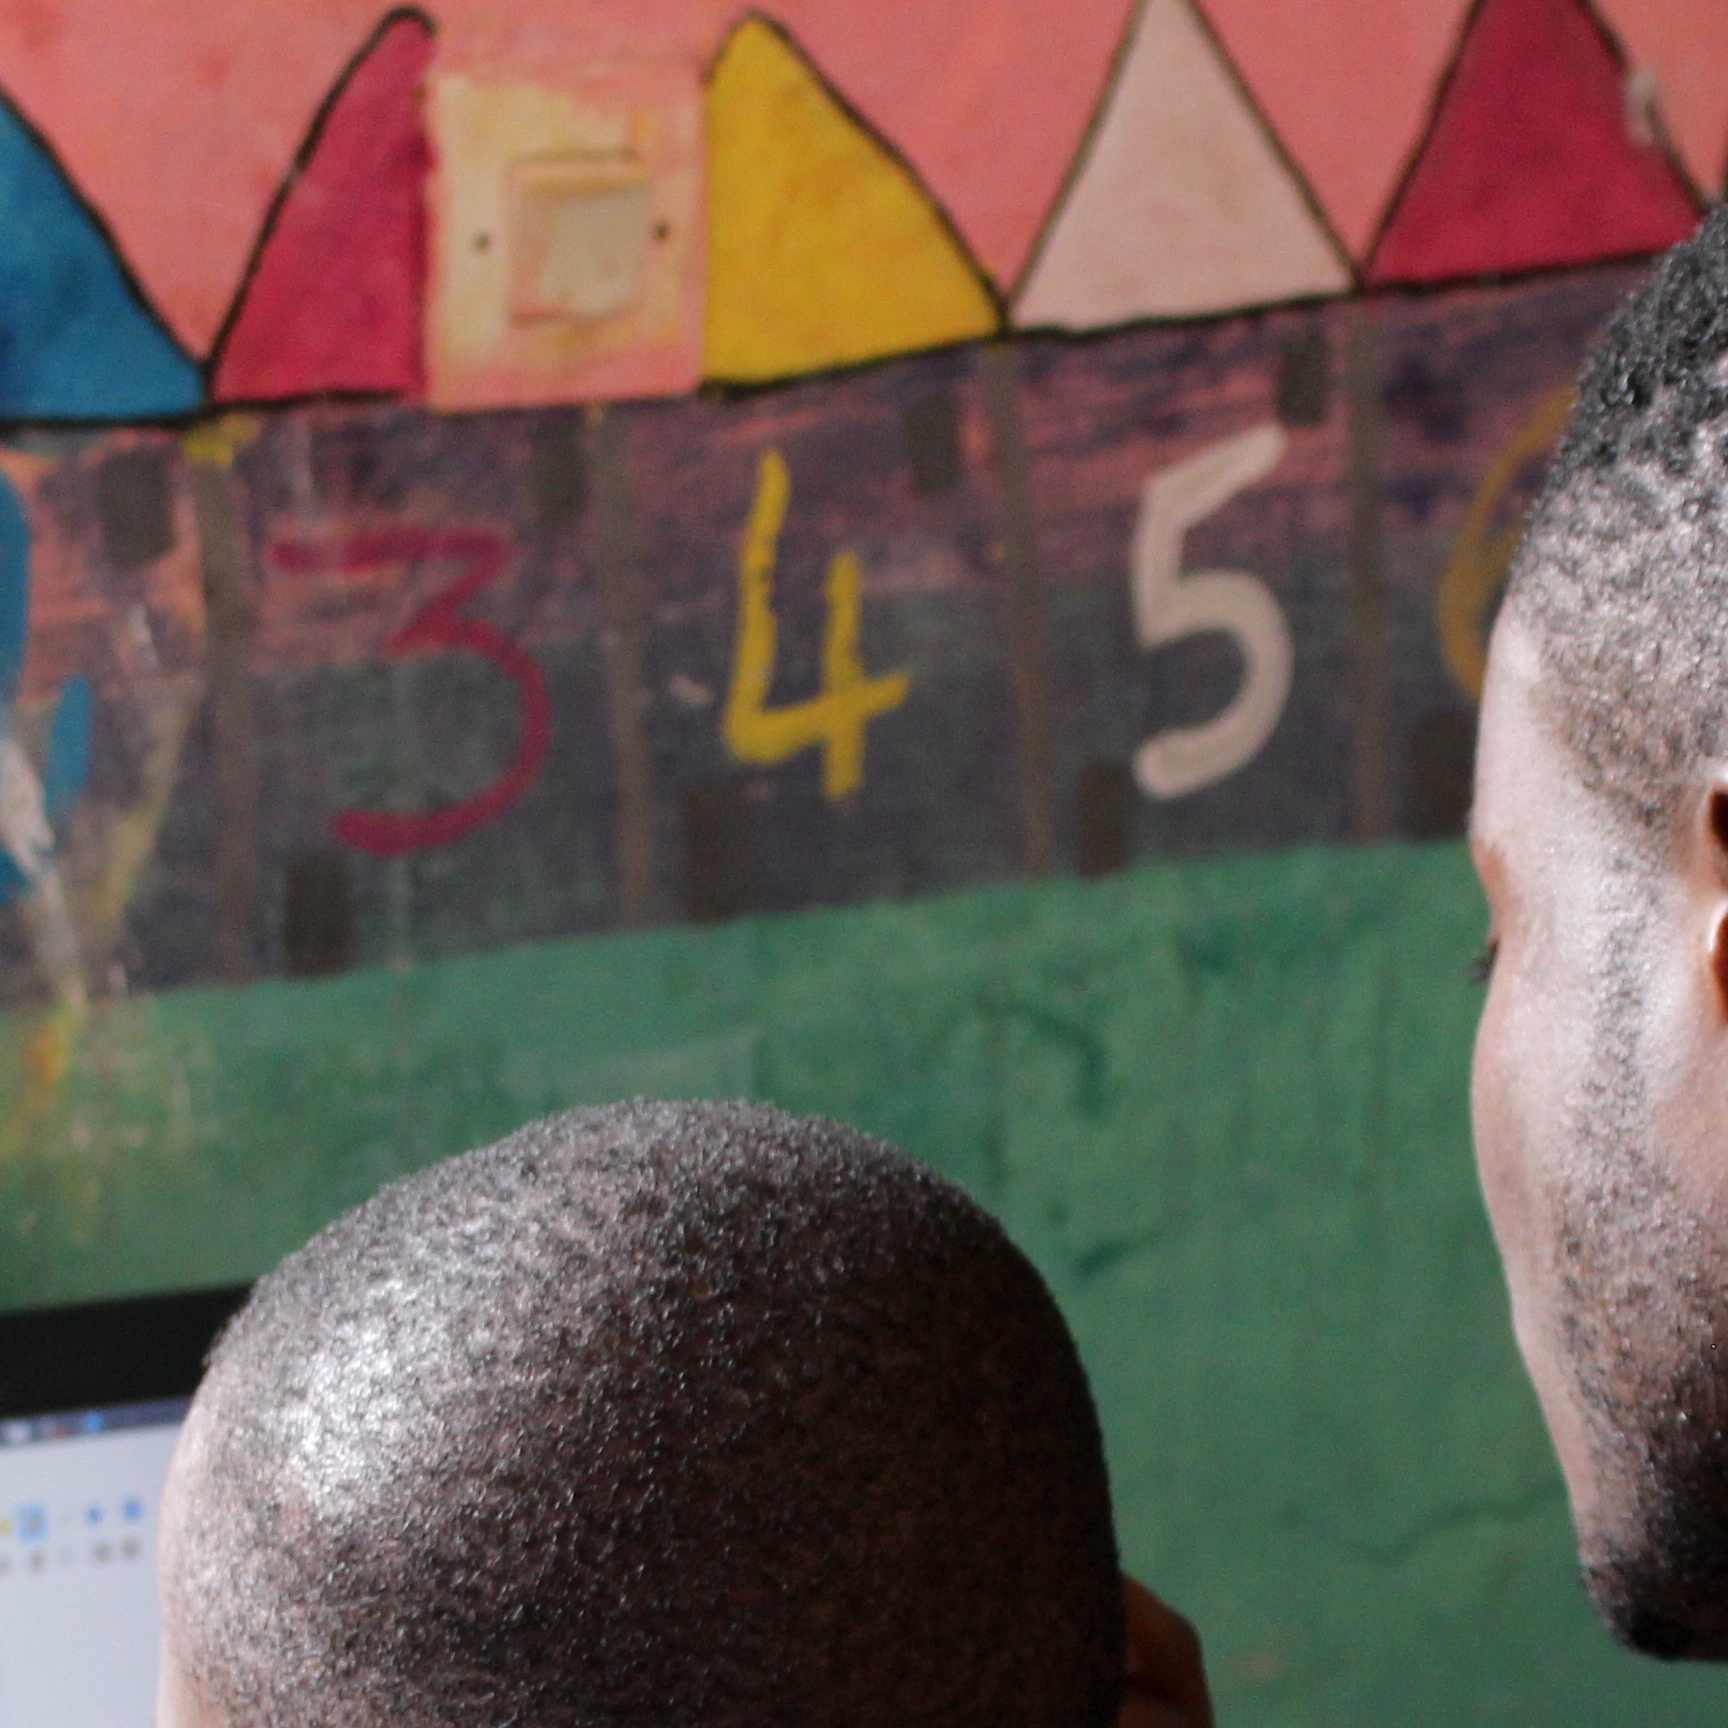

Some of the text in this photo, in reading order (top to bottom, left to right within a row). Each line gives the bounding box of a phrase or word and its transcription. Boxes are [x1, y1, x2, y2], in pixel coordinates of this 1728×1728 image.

[272, 528, 550, 855] 3
[724, 450, 909, 798] 4
[1132, 425, 1292, 797] 5
